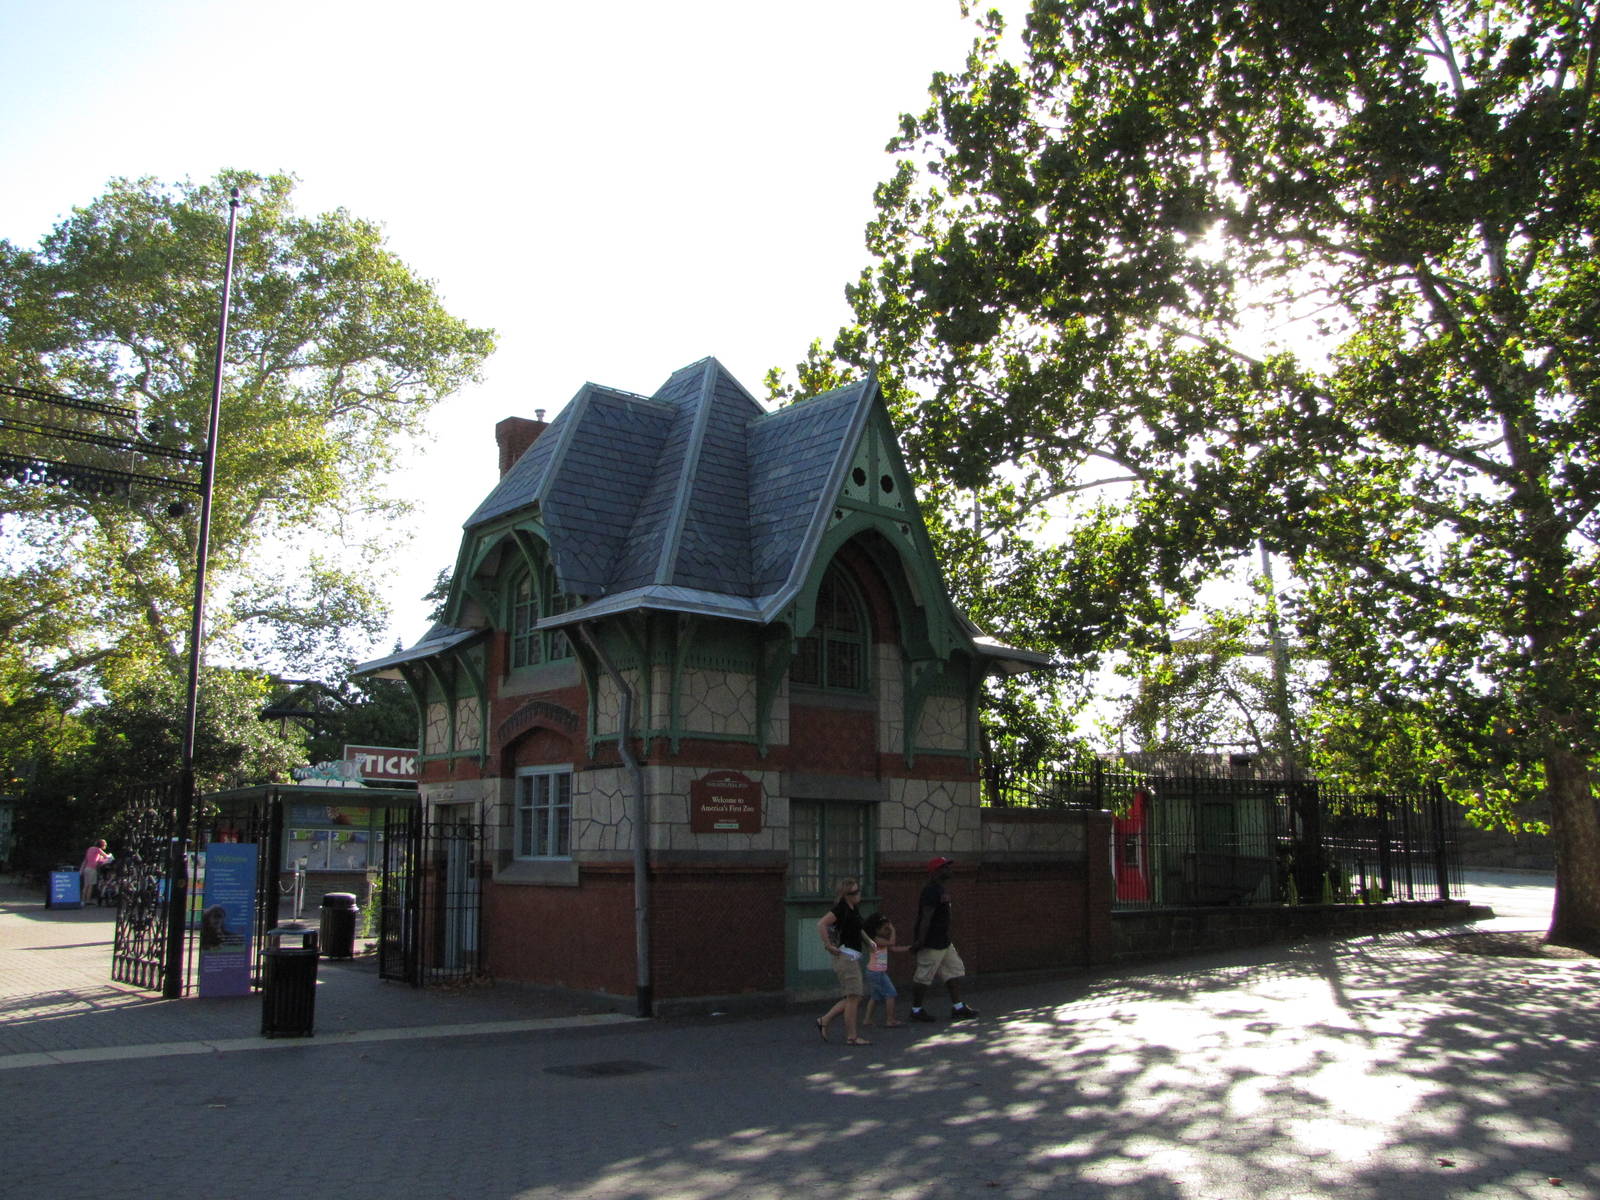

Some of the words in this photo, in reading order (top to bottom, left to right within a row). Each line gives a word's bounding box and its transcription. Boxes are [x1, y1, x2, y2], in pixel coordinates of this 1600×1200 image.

[364, 754, 416, 776] TICK
[711, 795, 737, 804] Welcome
[701, 804, 728, 812] America's
[729, 804, 742, 812] First
